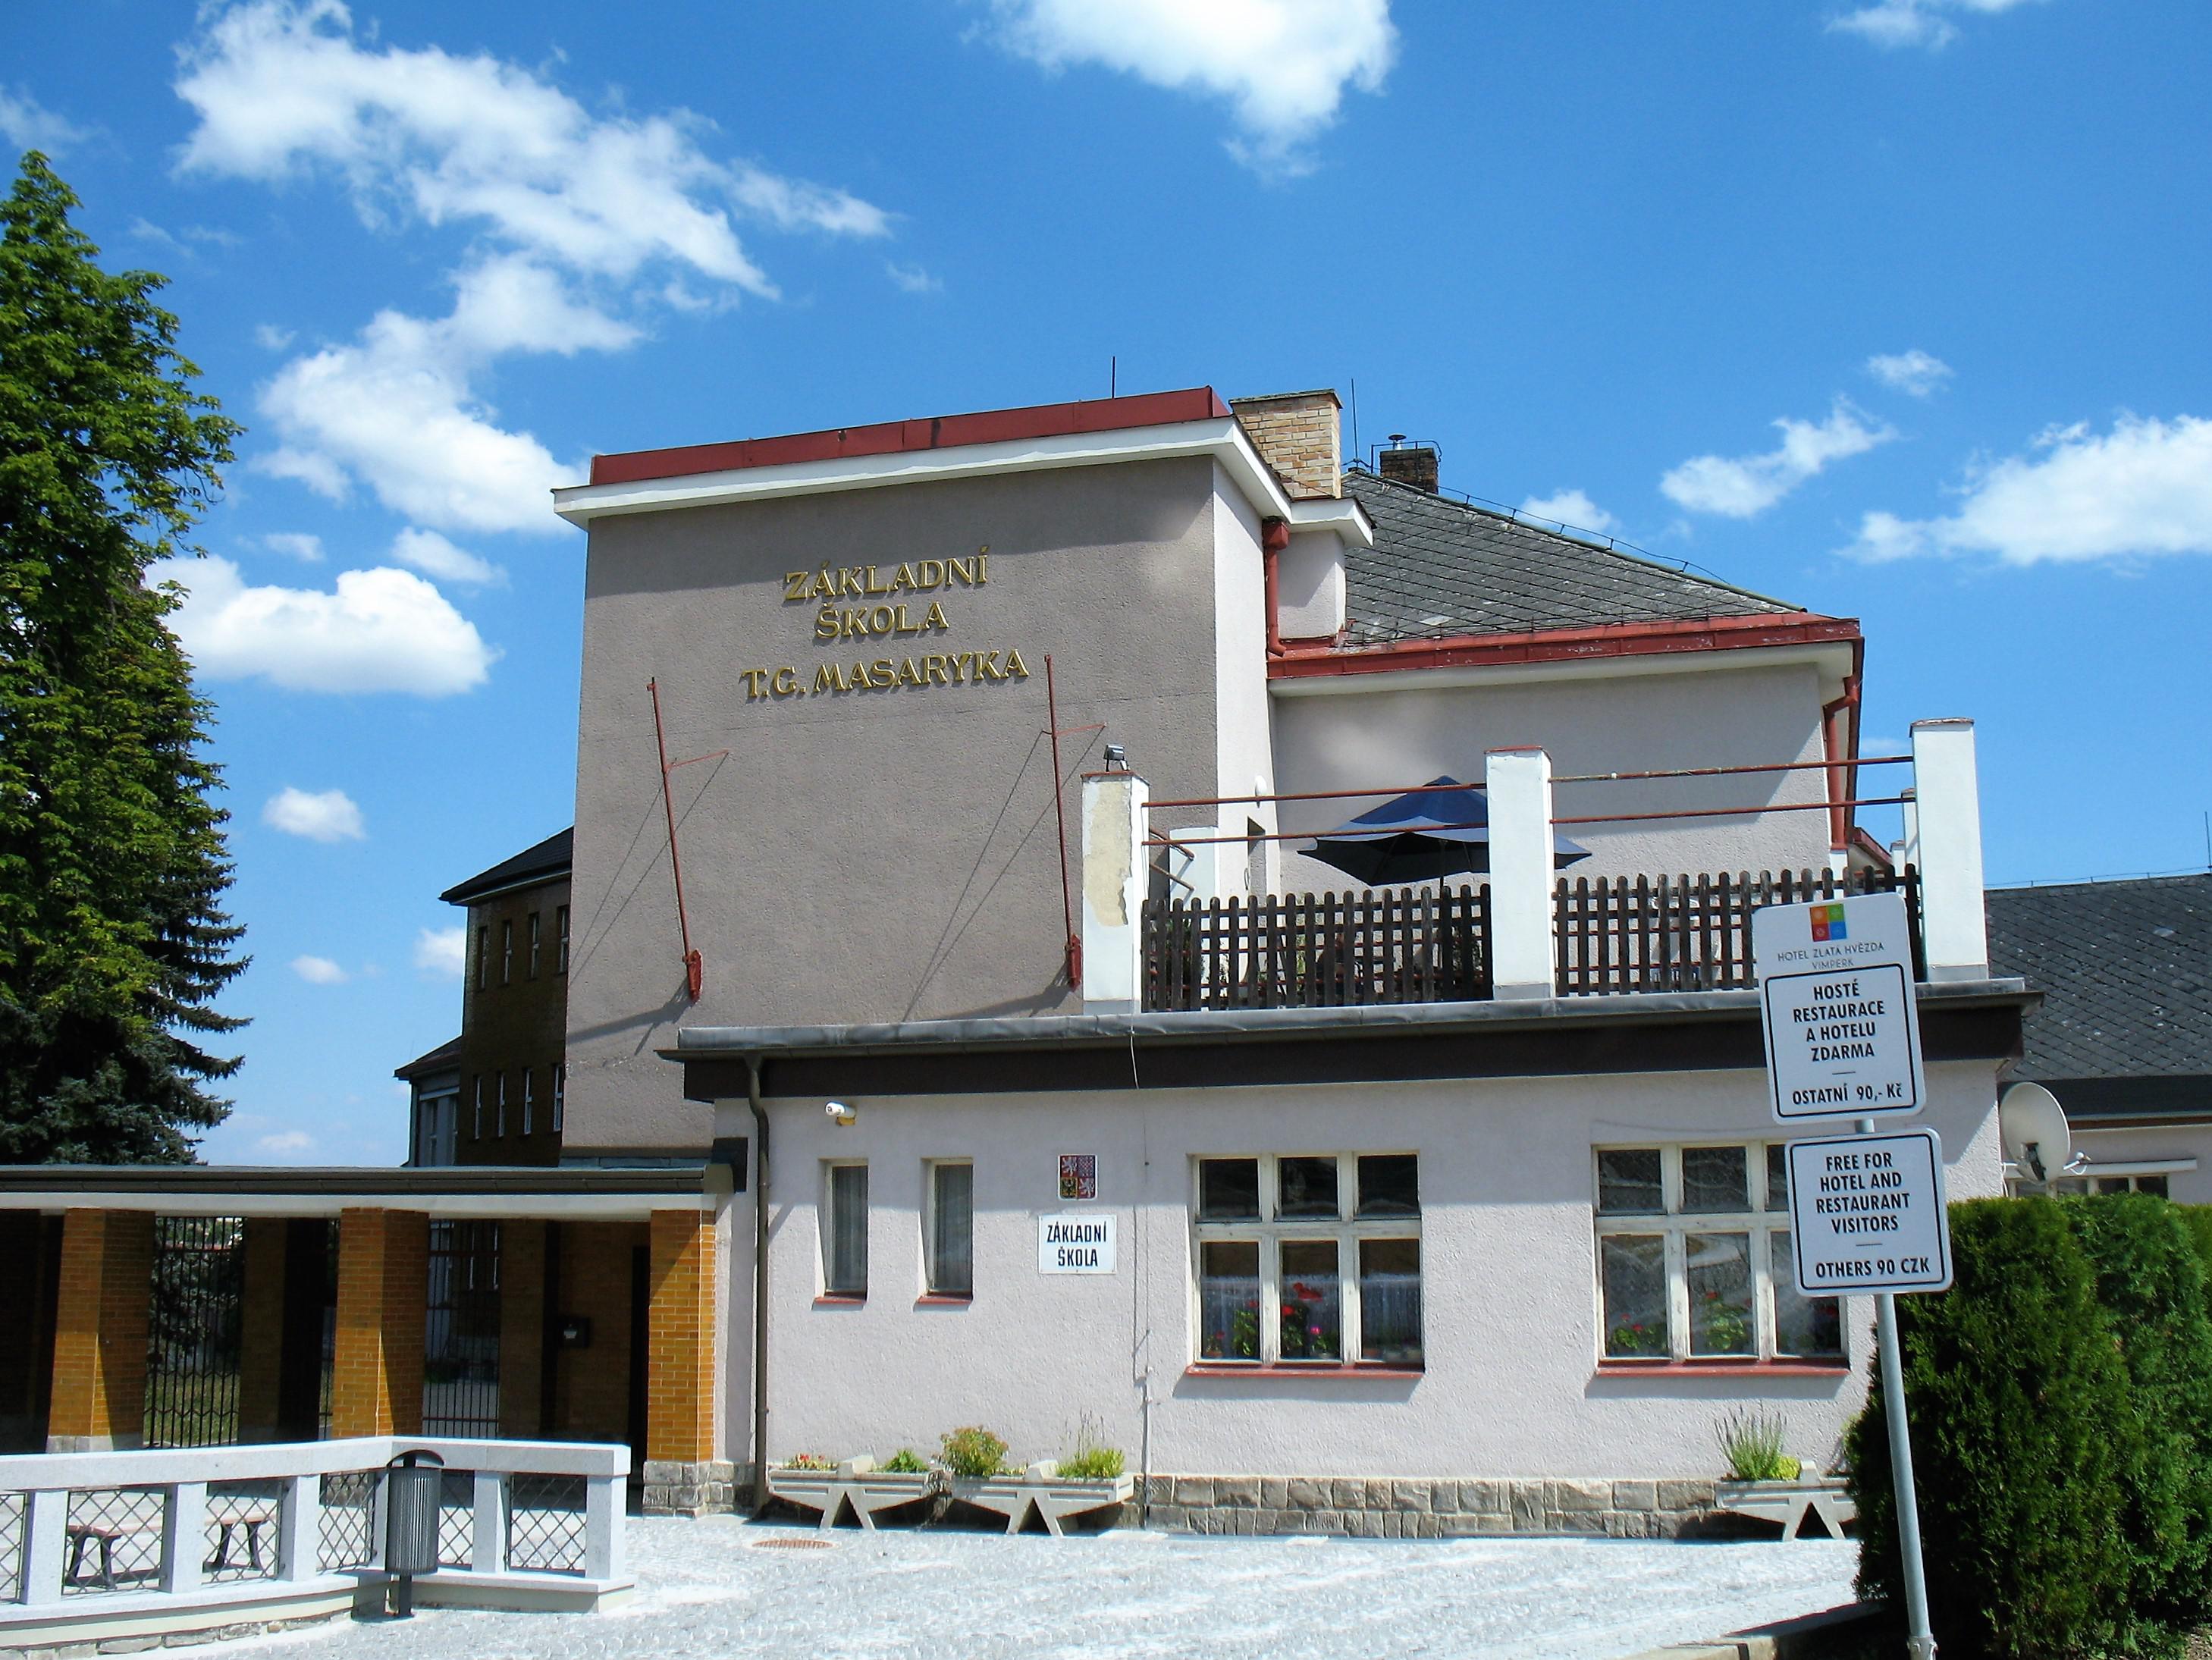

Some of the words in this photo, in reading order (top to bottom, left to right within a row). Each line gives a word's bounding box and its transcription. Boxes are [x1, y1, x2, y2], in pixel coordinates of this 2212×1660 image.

[784, 546, 988, 601] ZÁKLADNÍ
[814, 601, 949, 639] ŠKOLA
[816, 649, 1030, 692] MASARYKA
[1777, 950, 1809, 962] HOTEL
[1813, 946, 1843, 959] ZLATÁ
[1812, 958, 1854, 970] VIMPERK
[1813, 978, 1860, 1000] HOSTÉ
[1793, 1000, 1885, 1024] RESTAURACE
[1806, 1028, 1816, 1042] A
[1821, 1021, 1876, 1040] HOTELU
[1812, 1043, 1875, 1062] ZDARMA
[1793, 1083, 1848, 1105] OSTATNÍ
[1856, 1085, 1882, 1102] 90,-
[1887, 1082, 1903, 1098] Kč
[1826, 1155, 1859, 1172] FREE
[1865, 1152, 1893, 1169] FOR
[1820, 1175, 1865, 1192] HOTEL
[1871, 1172, 1903, 1189] AND
[1816, 1193, 1910, 1214] RESTAURANT
[1046, 1221, 1106, 1243] ZÁKLADNÍ
[1831, 1216, 1900, 1235] VISITORS
[1058, 1245, 1098, 1266] ŠKOLA
[1815, 1260, 1872, 1279] OTHERS
[1877, 1259, 1896, 1276] 90
[1900, 1257, 1931, 1275] CZK
